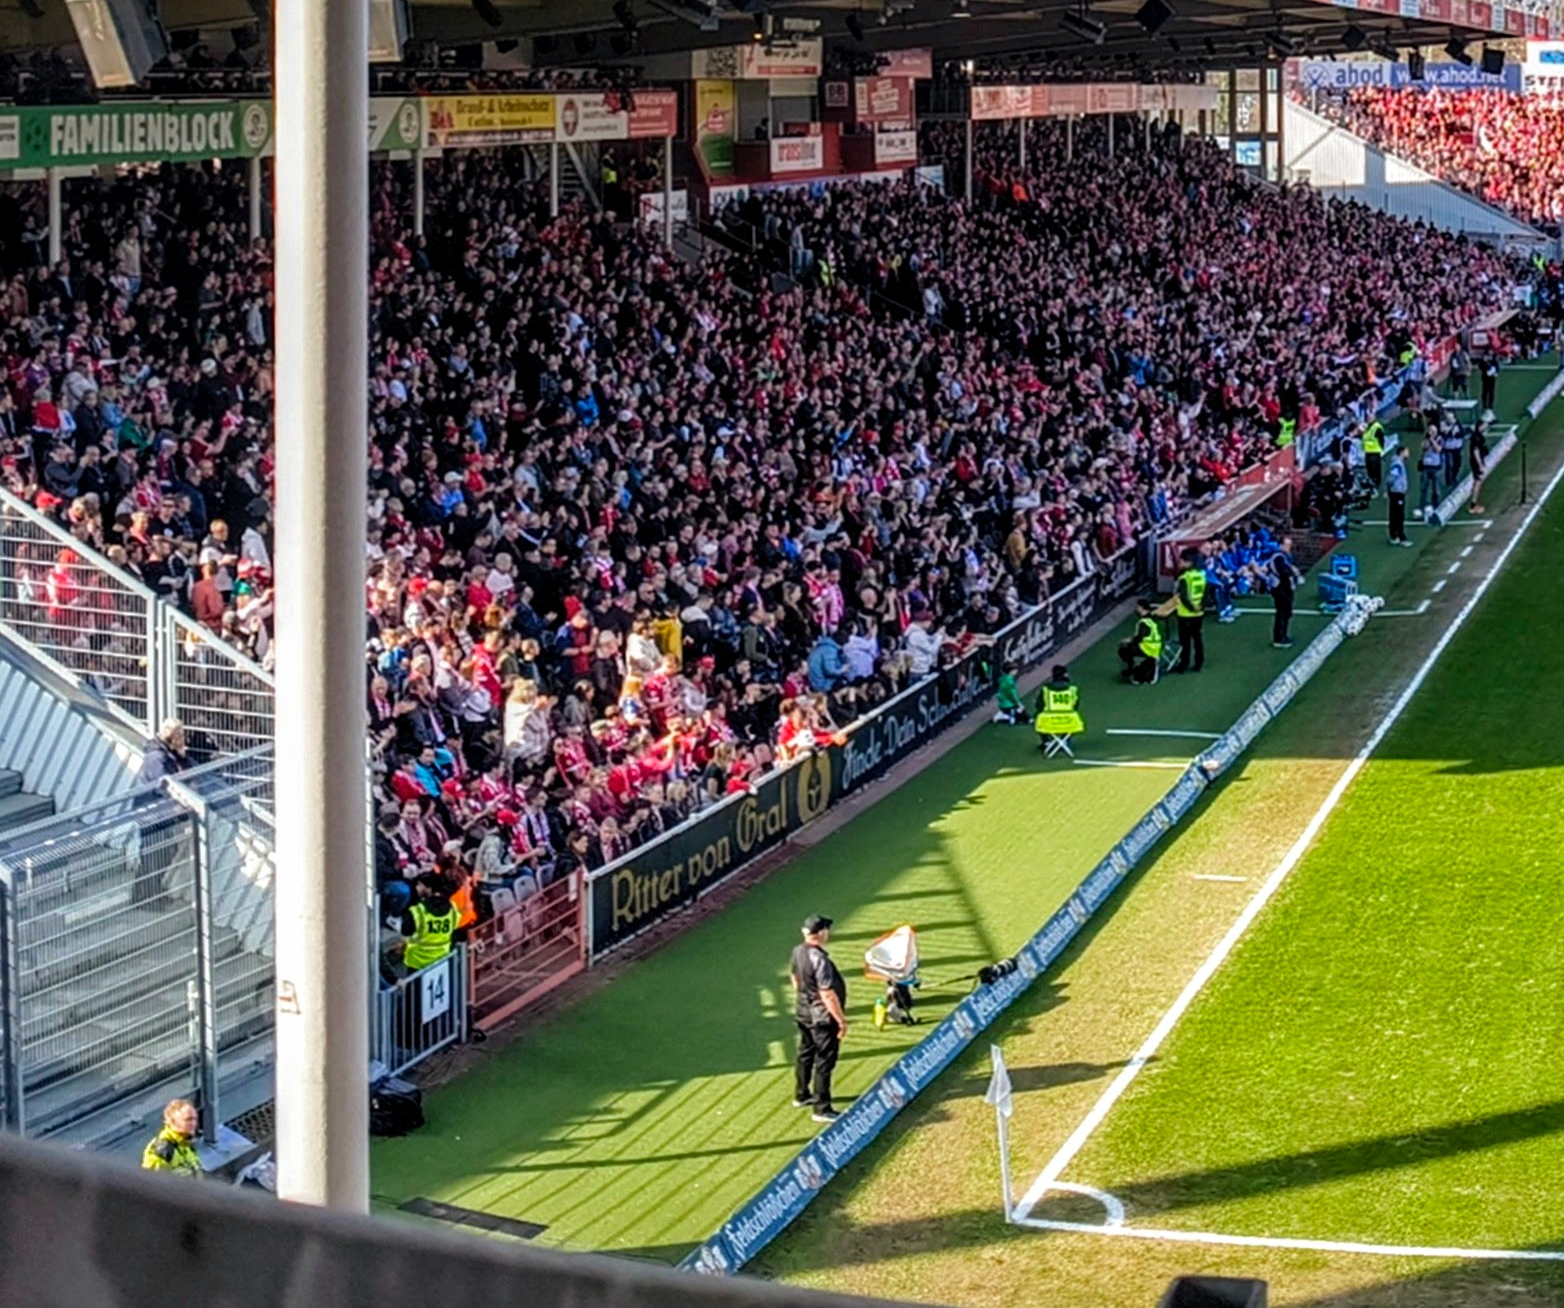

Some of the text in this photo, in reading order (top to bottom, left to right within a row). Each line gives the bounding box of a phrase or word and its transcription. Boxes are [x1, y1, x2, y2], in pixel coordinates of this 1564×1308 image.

[1335, 65, 1382, 85] ahod
[51, 111, 235, 156] FAMILIENBLOCK
[842, 737, 883, 791] Finde
[611, 774, 788, 932] Ritter von Gral
[427, 918, 450, 934] 138
[427, 973, 445, 1010] 14
